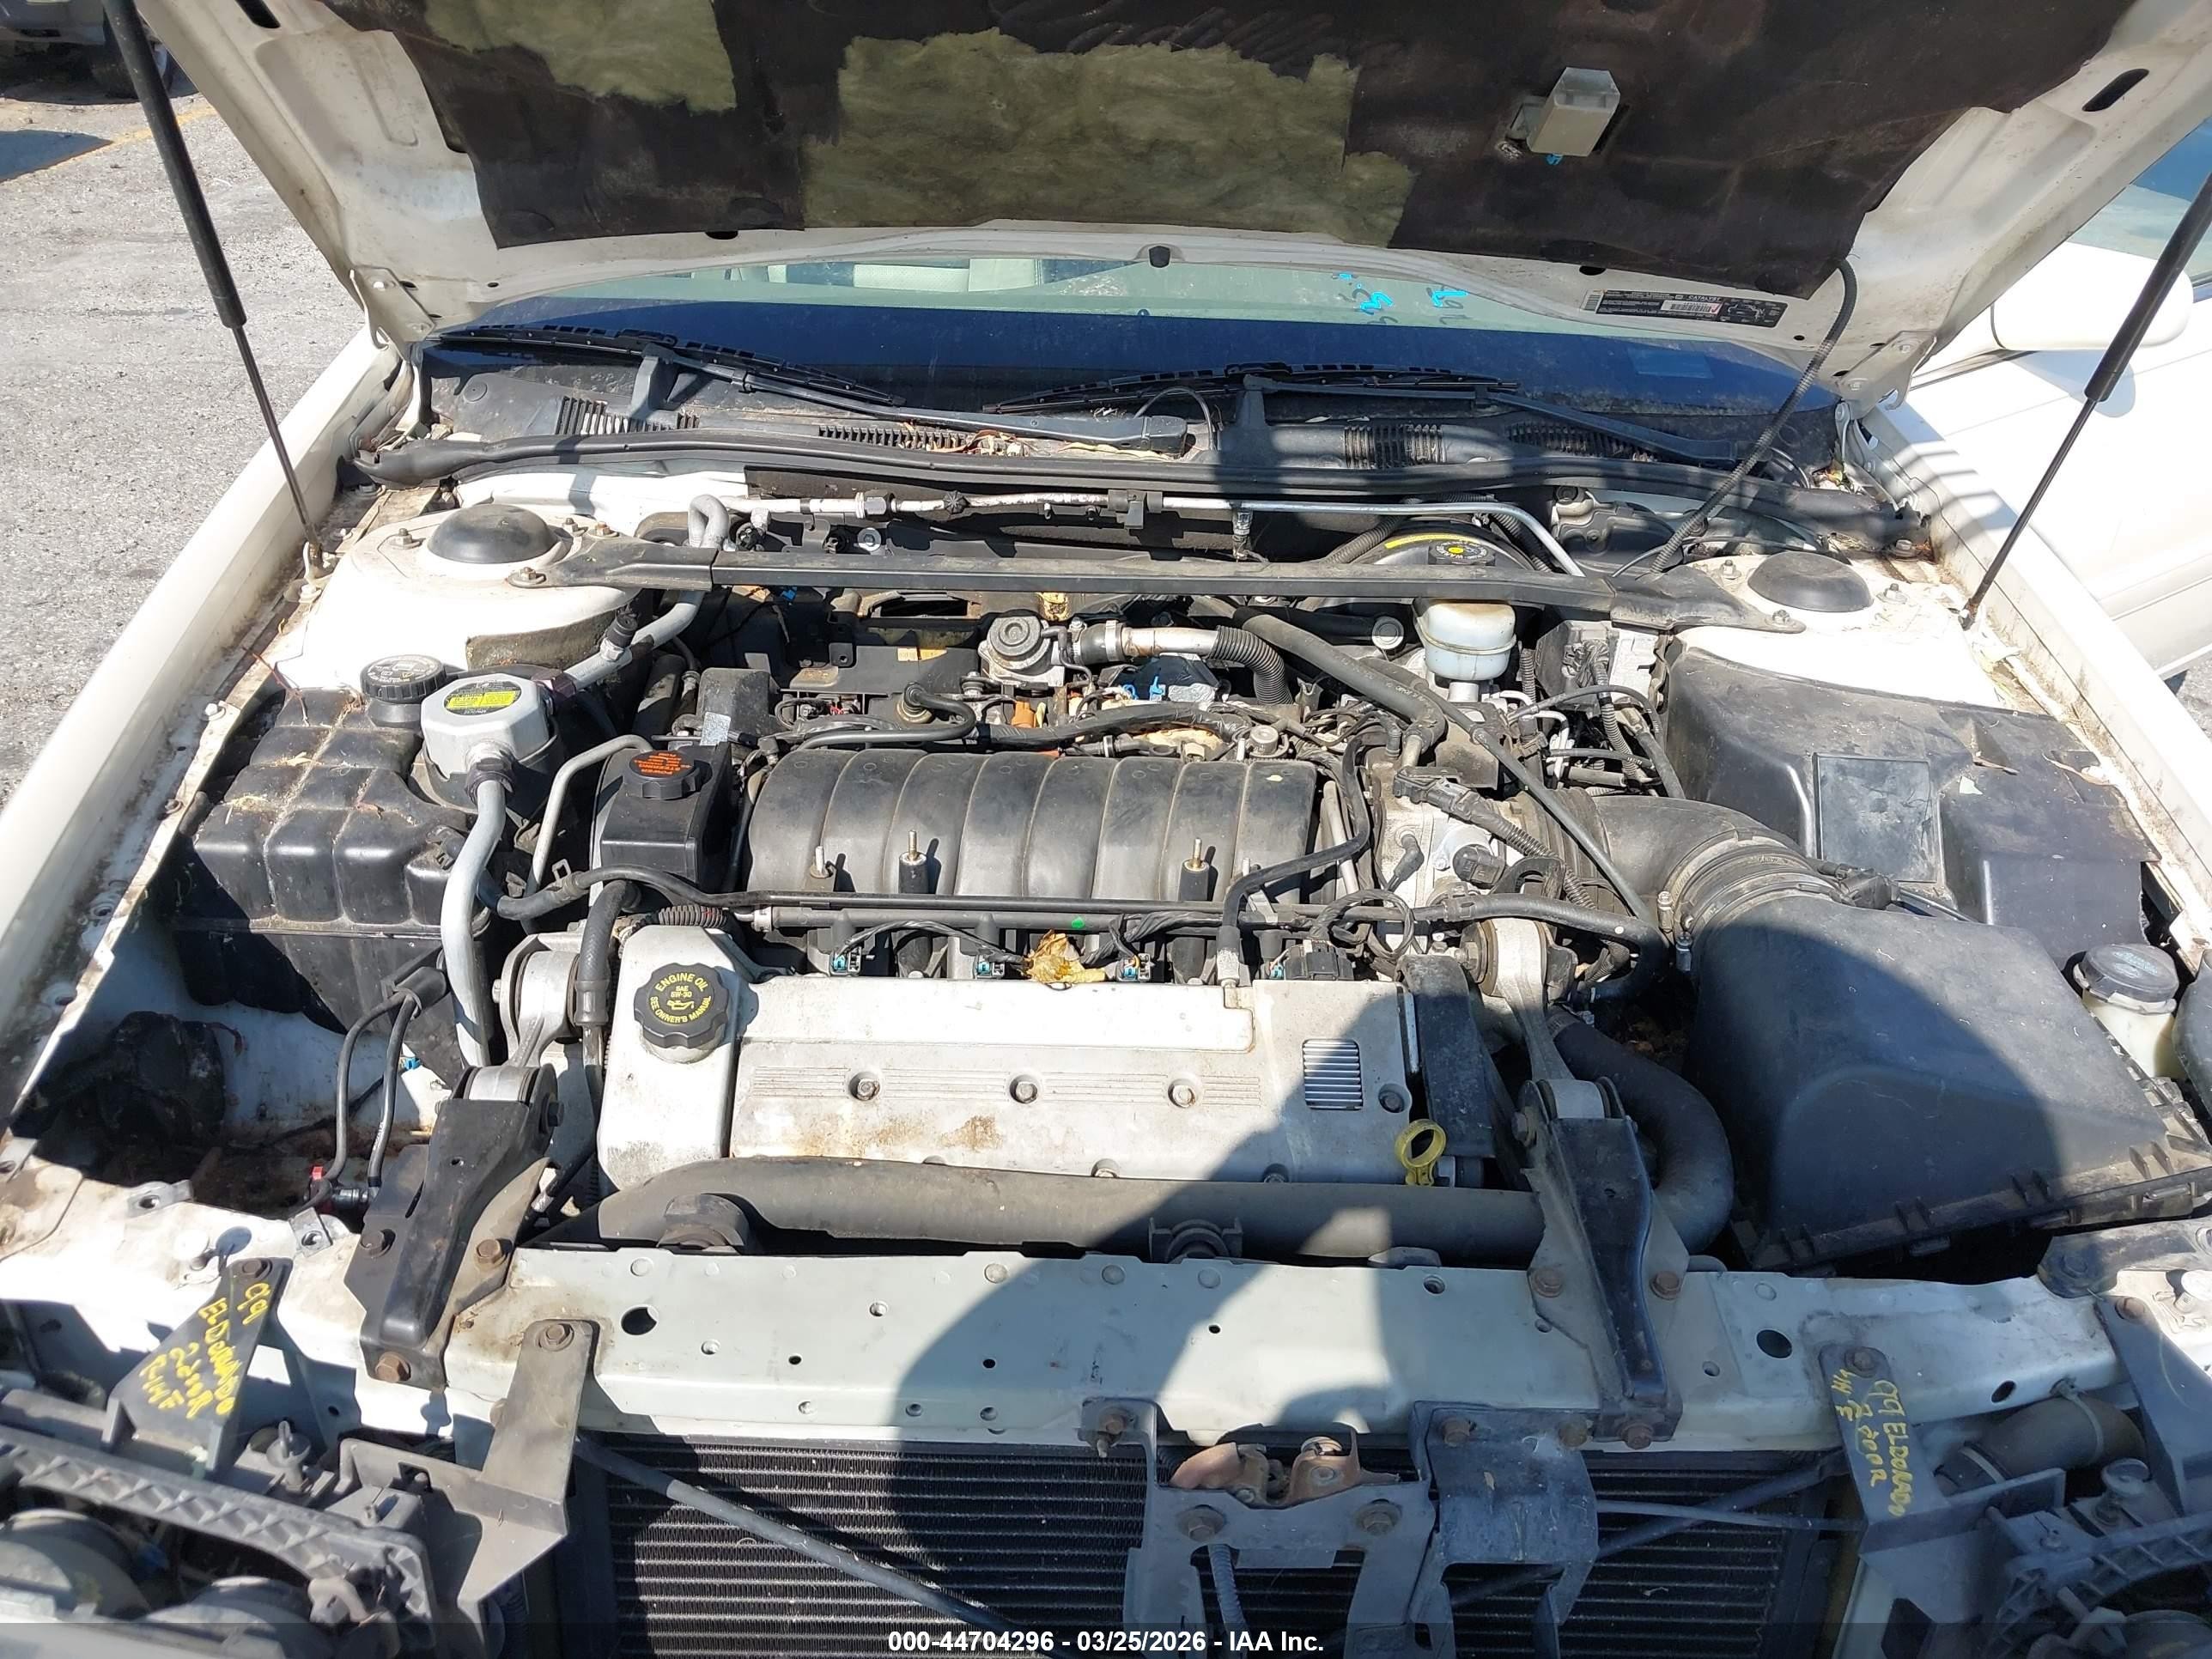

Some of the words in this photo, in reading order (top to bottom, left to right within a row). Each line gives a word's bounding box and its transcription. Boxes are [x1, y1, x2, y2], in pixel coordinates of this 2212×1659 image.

[654, 973, 696, 992] ENGINE
[694, 977, 708, 992] OIL
[649, 996, 660, 1011] SEE
[688, 995, 712, 1021] MANUAL
[654, 1009, 688, 1024] OWNER'S
